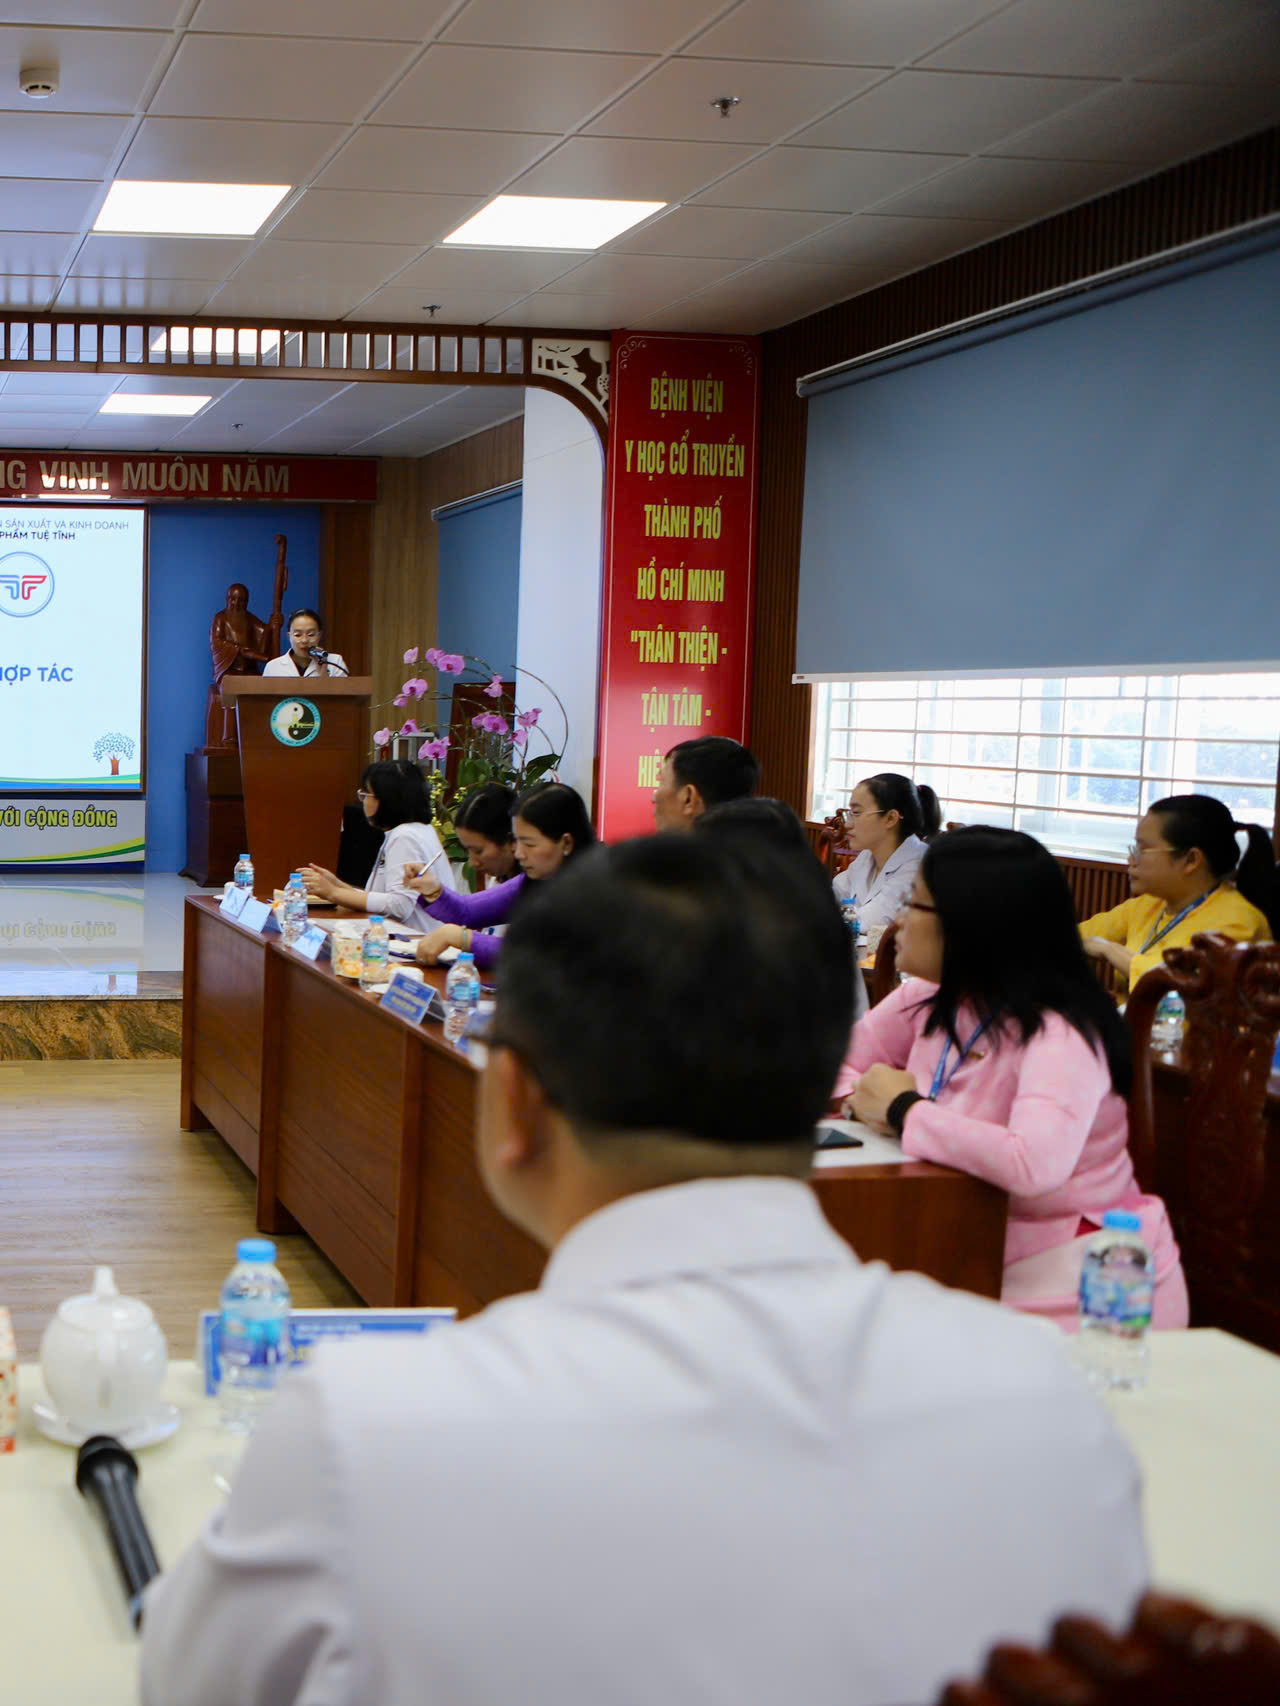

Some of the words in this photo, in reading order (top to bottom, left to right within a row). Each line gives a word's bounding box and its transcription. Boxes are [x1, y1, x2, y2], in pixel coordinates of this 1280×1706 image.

[650, 371, 688, 418] BỆNH
[692, 372, 724, 420] VIỆN
[39, 460, 109, 490] VINH
[122, 455, 209, 492] MUÔN
[222, 457, 289, 493] NĂM
[625, 440, 634, 473] Y
[637, 440, 665, 481] HỌC
[669, 429, 690, 475] CỔ
[0, 528, 28, 540] PHẨM
[31, 529, 49, 541] TUỆ
[69, 520, 92, 529] KINH
[95, 521, 129, 530] DOANH
[644, 497, 690, 538] THÀNH
[693, 495, 723, 540] PHỐ
[637, 556, 656, 600] HỒ
[660, 561, 685, 601] CHÍ
[687, 569, 725, 602] MINH
[678, 625, 719, 671] THIỆN
[37, 662, 73, 682] TÁC
[641, 686, 669, 733] TẬN
[672, 687, 703, 726] TÂM
[25, 805, 70, 830] CỘNG
[72, 804, 118, 828] ĐỒNG
